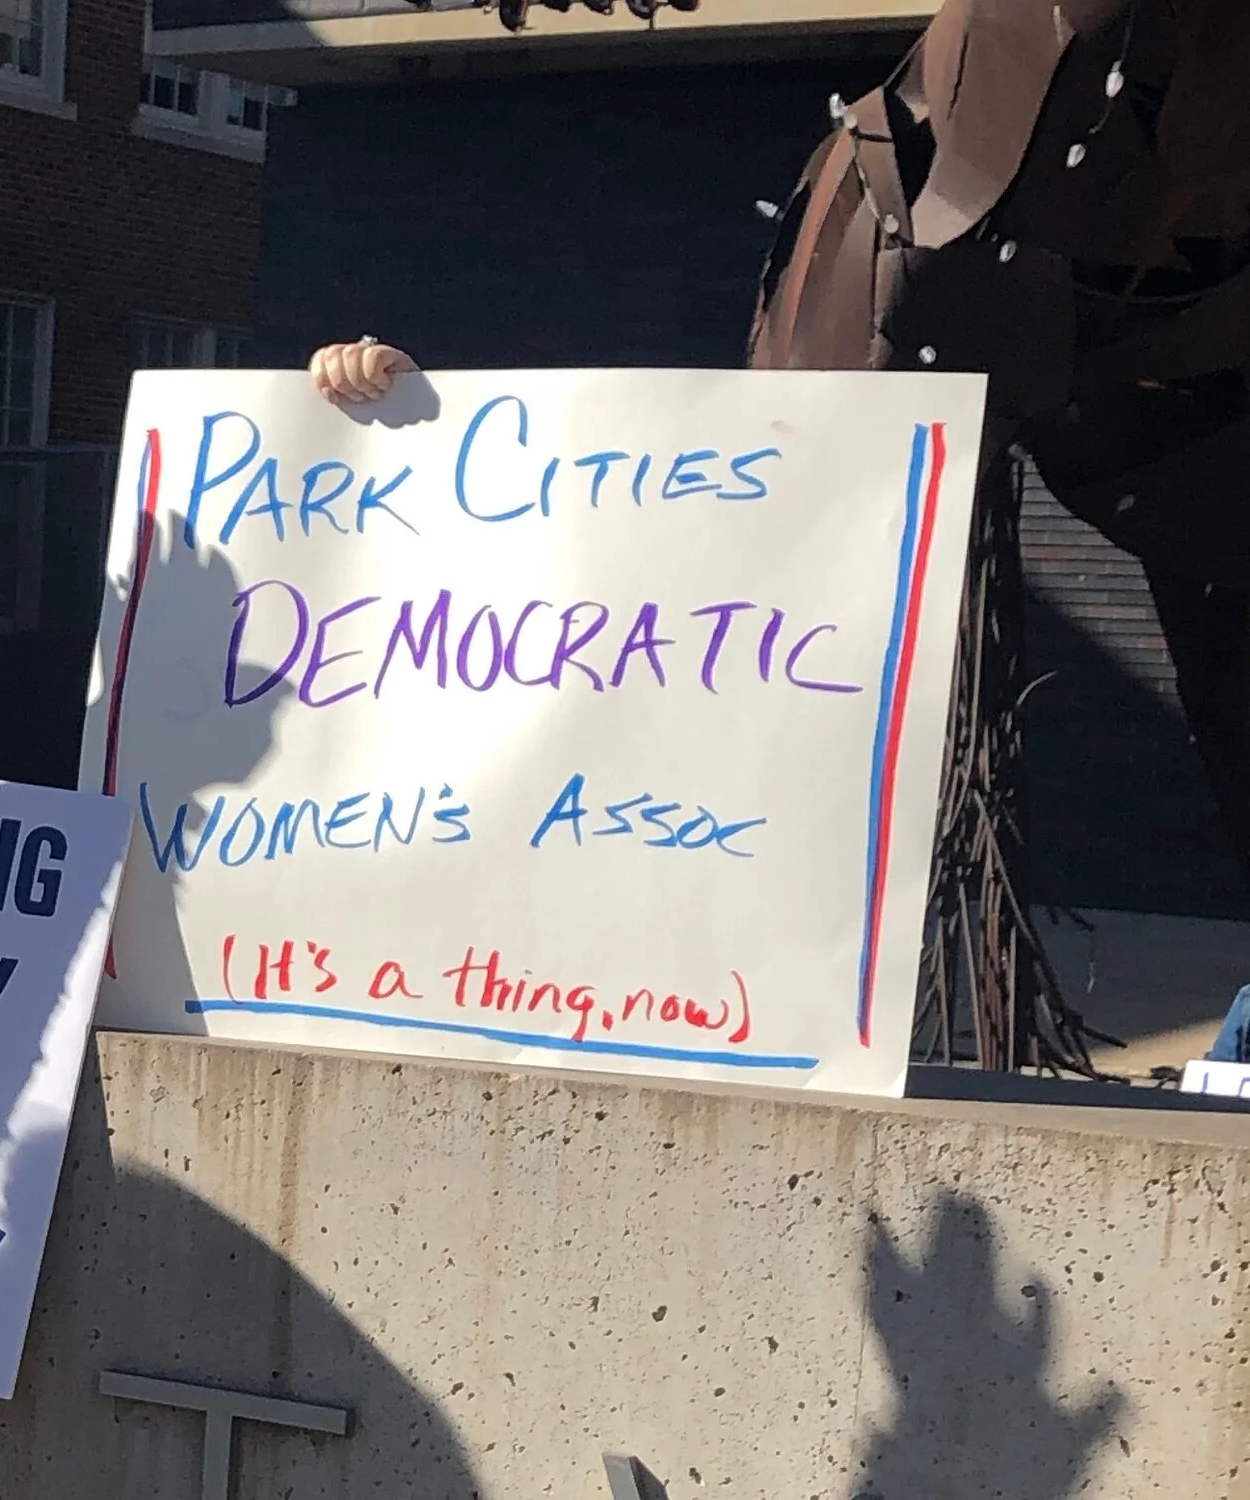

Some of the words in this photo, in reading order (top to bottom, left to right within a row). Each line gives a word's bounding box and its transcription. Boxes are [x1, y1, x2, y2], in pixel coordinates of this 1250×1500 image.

[184, 411, 420, 549] PARK
[455, 395, 782, 522] CITIES
[224, 579, 863, 708] DEMOCRATIC
[368, 960, 424, 999] a
